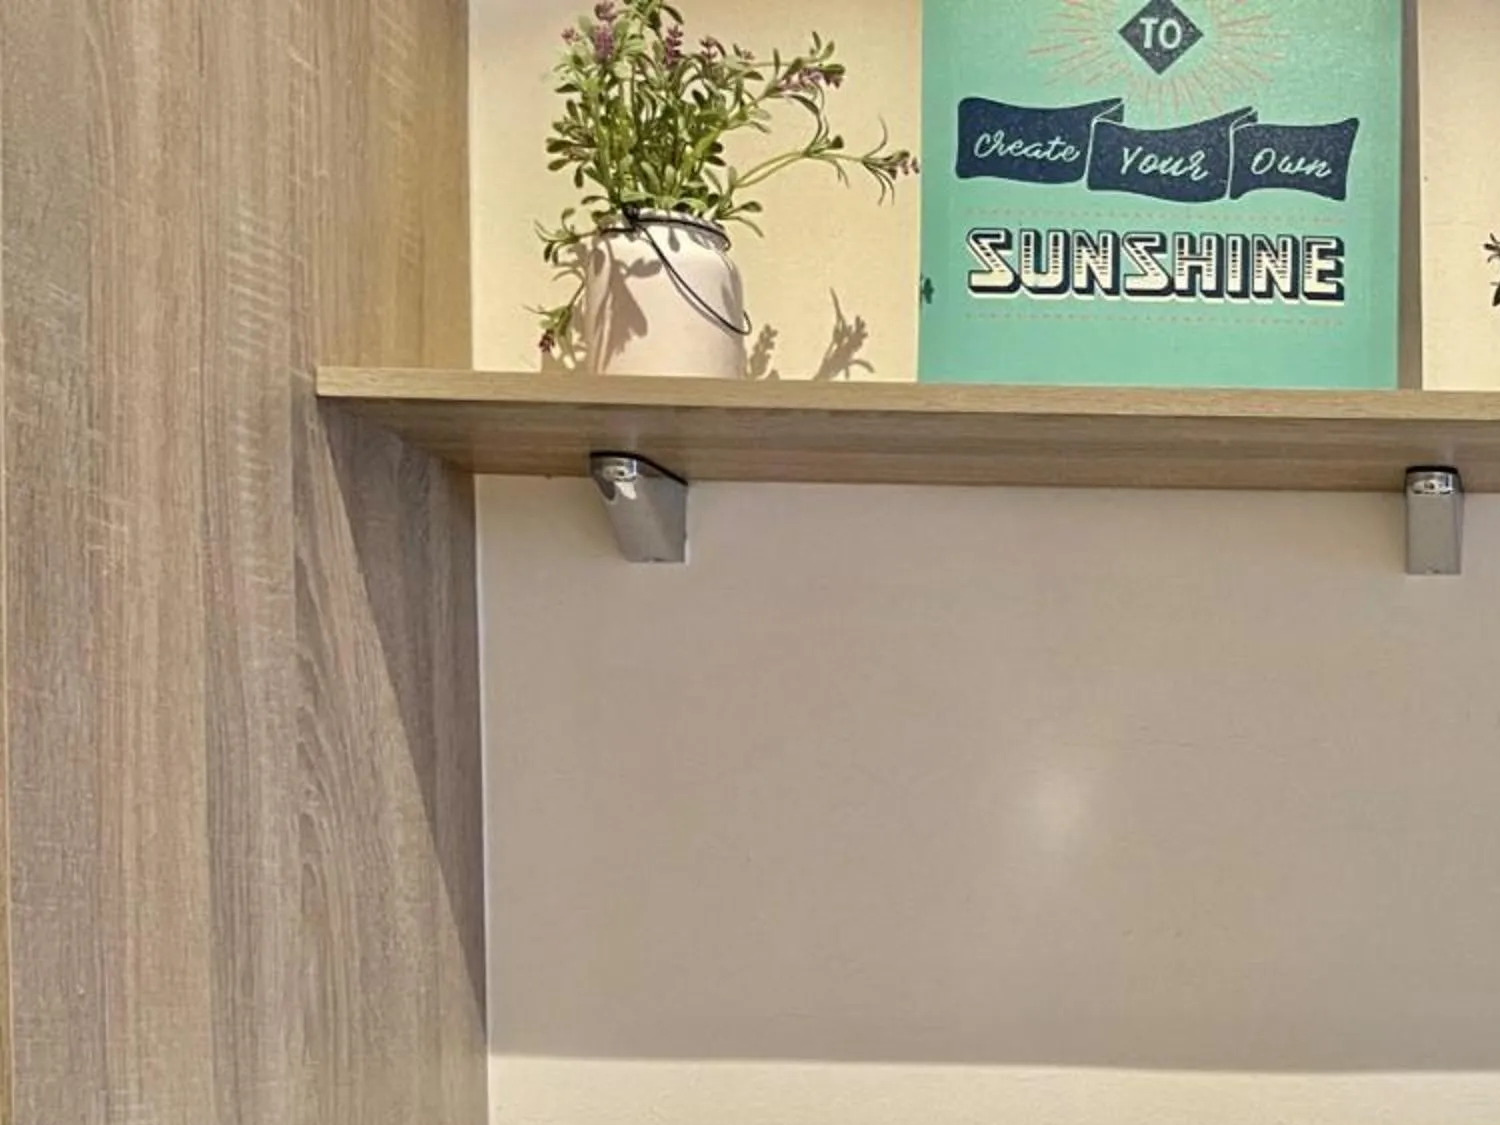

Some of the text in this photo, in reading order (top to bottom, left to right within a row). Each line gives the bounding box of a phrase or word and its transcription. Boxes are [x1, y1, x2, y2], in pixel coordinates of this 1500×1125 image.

[1139, 16, 1183, 49] TO
[974, 130, 1332, 182] Create Your Own
[967, 227, 1345, 305] SUNSHINE
